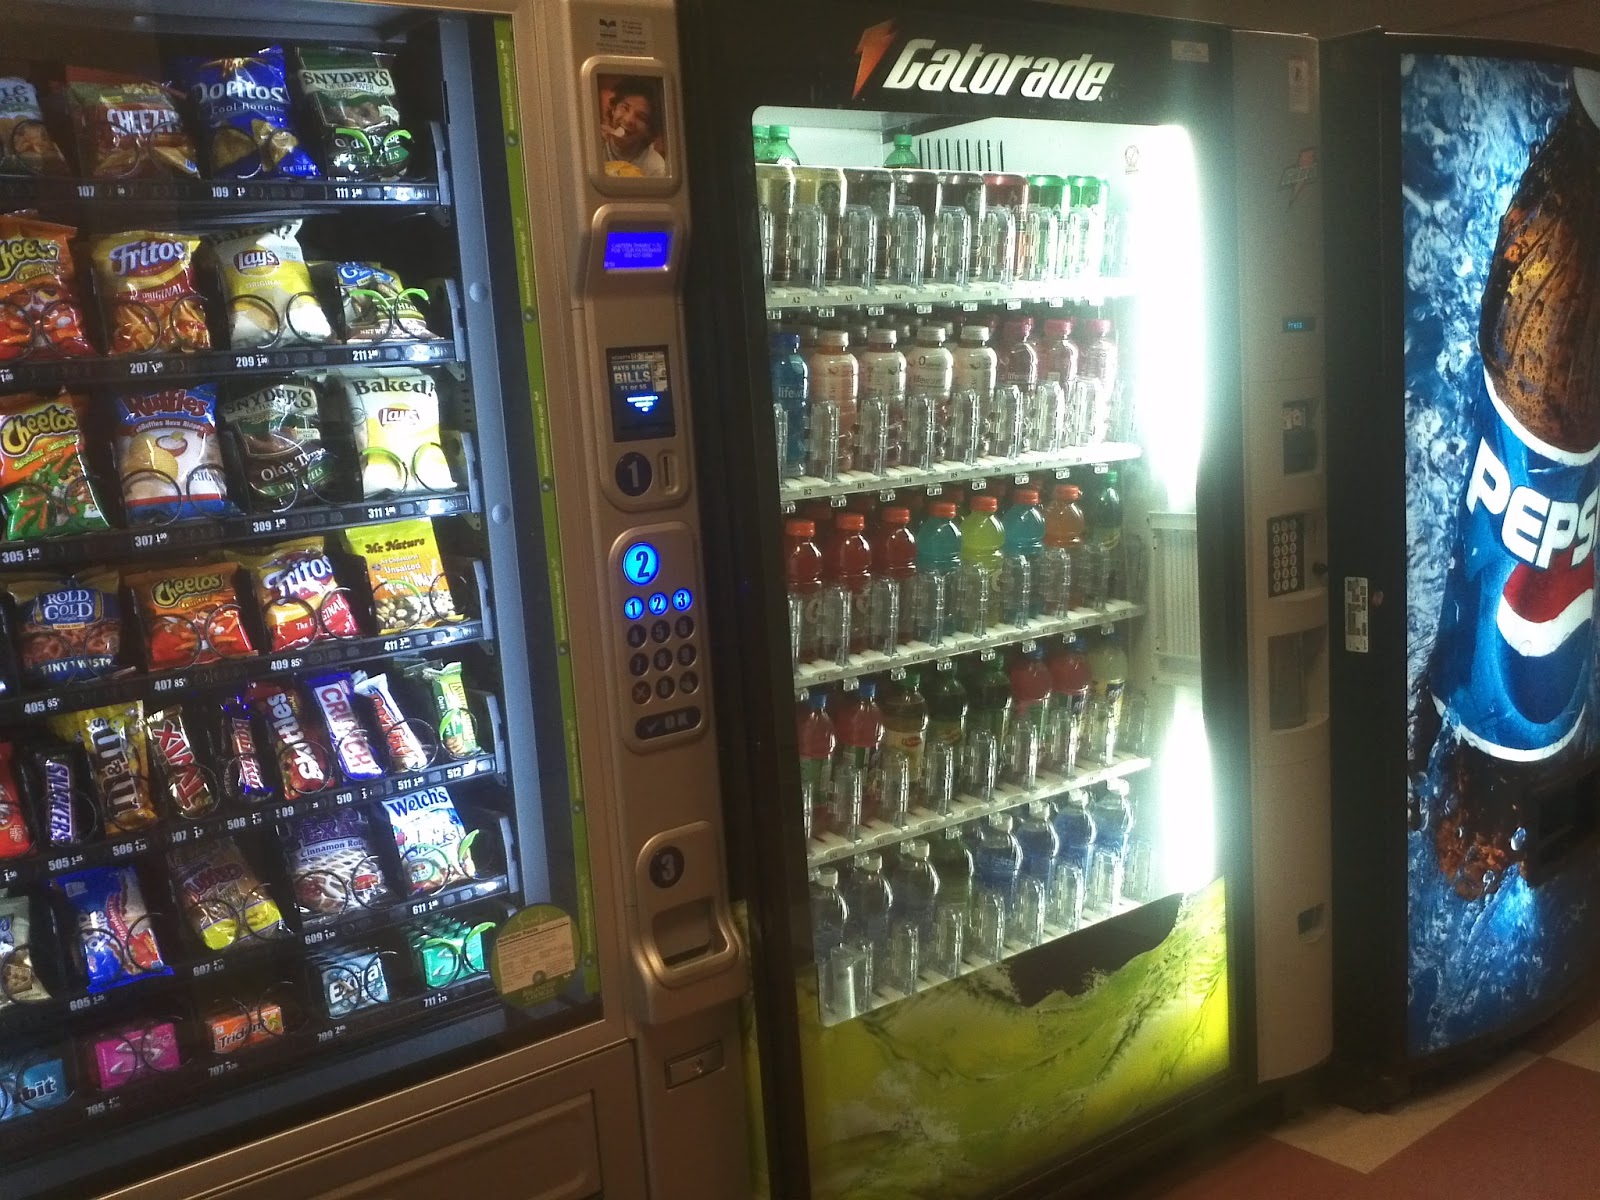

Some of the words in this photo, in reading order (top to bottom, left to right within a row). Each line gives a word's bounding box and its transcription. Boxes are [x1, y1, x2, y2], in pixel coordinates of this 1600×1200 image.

[883, 38, 1114, 102] Gatorade
[302, 70, 391, 87] SNYDER'S
[192, 78, 284, 105] Doritos
[211, 103, 237, 114] Cool
[77, 186, 95, 197] 107
[212, 187, 229, 198] 109
[109, 241, 186, 275] Fritos
[238, 250, 278, 270] Lay's
[142, 284, 185, 300] ORIGINAL
[235, 356, 255, 368] 209
[352, 350, 367, 361] 211
[130, 362, 149, 374] 207
[613, 371, 651, 384] BILLS
[353, 376, 435, 397] Baked!
[225, 388, 312, 413] SNYDER'S
[2, 404, 77, 453] Cheetos
[627, 461, 639, 488] 1
[368, 507, 383, 519] 311
[252, 521, 272, 532] 309
[134, 535, 153, 547] 307
[385, 538, 425, 552] Nature
[2, 550, 24, 563] 305
[383, 563, 422, 574] Unsalted
[636, 551, 650, 578] 2
[263, 555, 333, 606] Fritos
[46, 589, 90, 605] ROLD
[155, 574, 220, 606] Cheetos
[44, 601, 93, 620] GOLD
[629, 601, 637, 615] 1
[654, 597, 662, 611] 2
[677, 592, 686, 607] 3
[384, 641, 398, 652] 411
[41, 660, 67, 675] TINY
[270, 659, 289, 671] 409
[154, 679, 172, 691] 407
[24, 701, 45, 714] 405
[321, 687, 372, 768] CRUCH
[267, 692, 324, 780] Skittles
[152, 719, 205, 811] TWIX
[447, 767, 462, 779] 512
[398, 779, 412, 790] 511
[47, 762, 73, 842] SNICKERS
[336, 794, 352, 805] 510
[387, 788, 448, 818] Welch's
[227, 817, 246, 830] 508
[112, 843, 133, 856] 506
[300, 842, 345, 858] Cinnamon
[48, 857, 70, 871] 505
[660, 854, 676, 880] 3
[413, 902, 426, 915] 611
[305, 933, 323, 945] 609
[328, 962, 385, 1005] Extra
[70, 998, 92, 1011] 605
[423, 995, 437, 1008] 711
[218, 1017, 267, 1049] Trident
[317, 1030, 334, 1042] 709
[21, 1075, 58, 1101] bit
